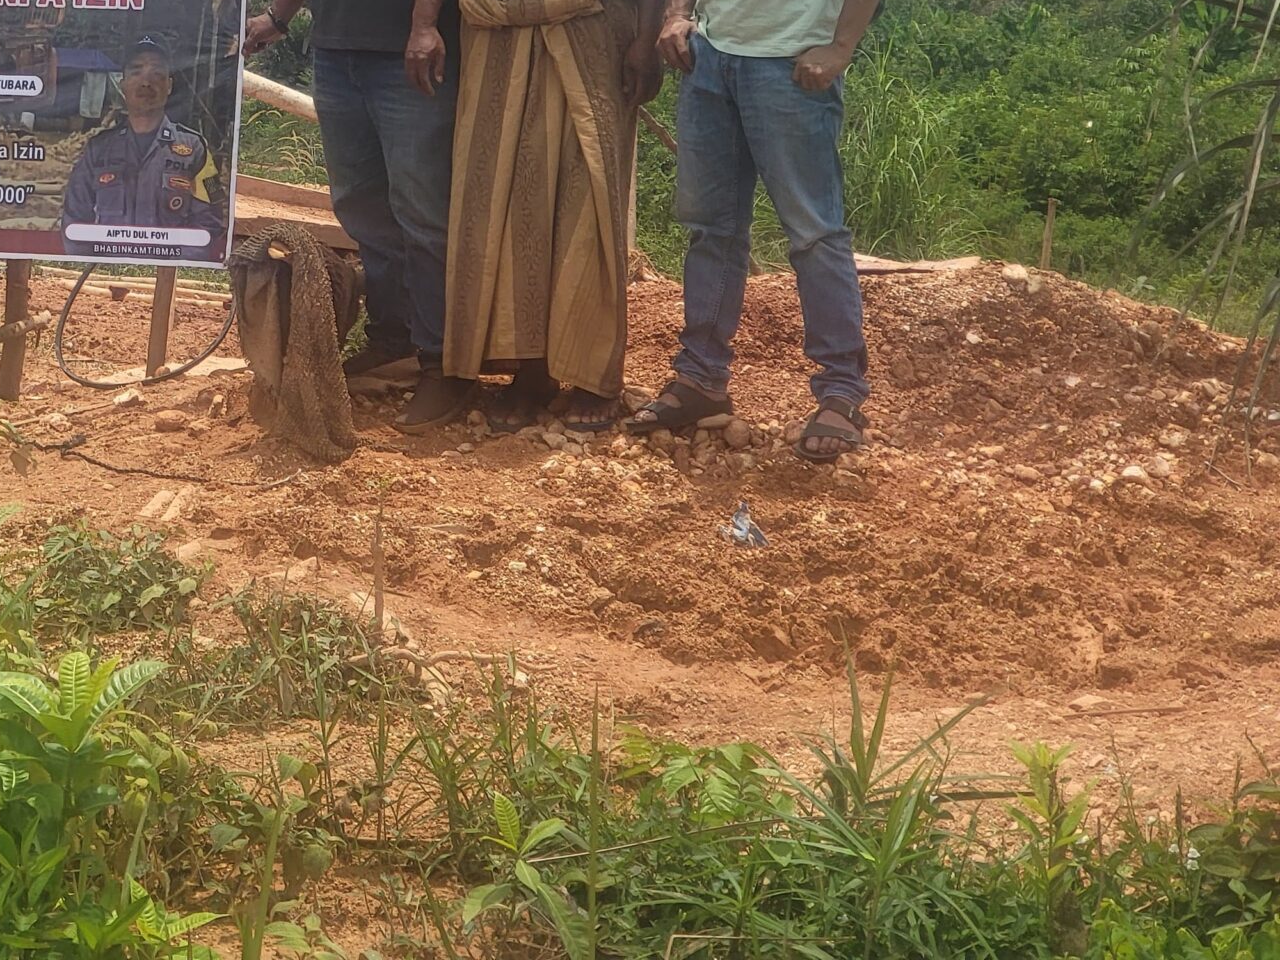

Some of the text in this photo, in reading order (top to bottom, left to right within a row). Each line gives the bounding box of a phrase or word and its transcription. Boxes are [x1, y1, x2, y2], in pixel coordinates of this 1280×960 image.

[13, 142, 44, 160] Izin
[106, 229, 169, 240] AIPTU DUL FOYI
[94, 244, 181, 256] BHABINKAMTIBMAS
